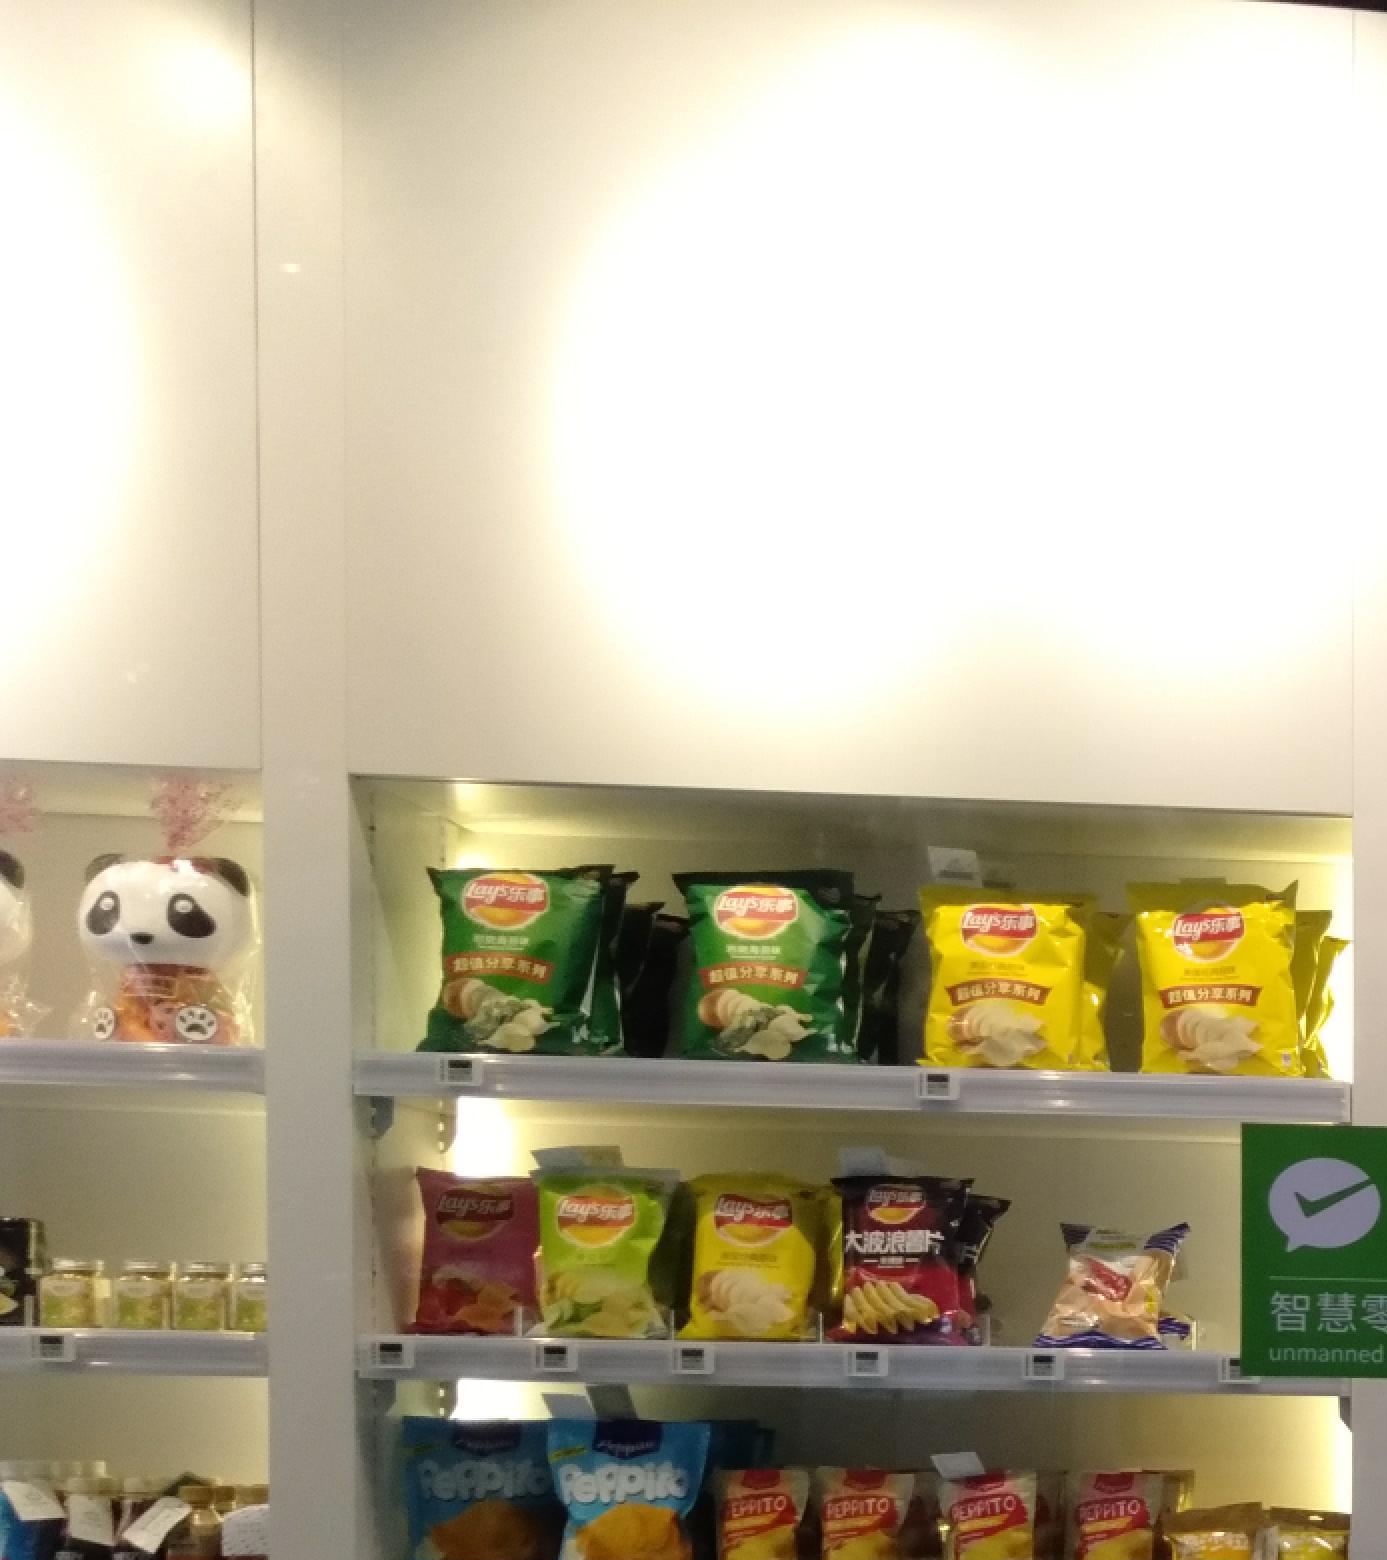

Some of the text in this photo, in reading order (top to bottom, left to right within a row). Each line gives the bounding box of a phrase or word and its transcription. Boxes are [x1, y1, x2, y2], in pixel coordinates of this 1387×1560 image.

[844, 1228, 945, 1255] 大波浪薯片
[1269, 1344, 1385, 1364] unmanned
